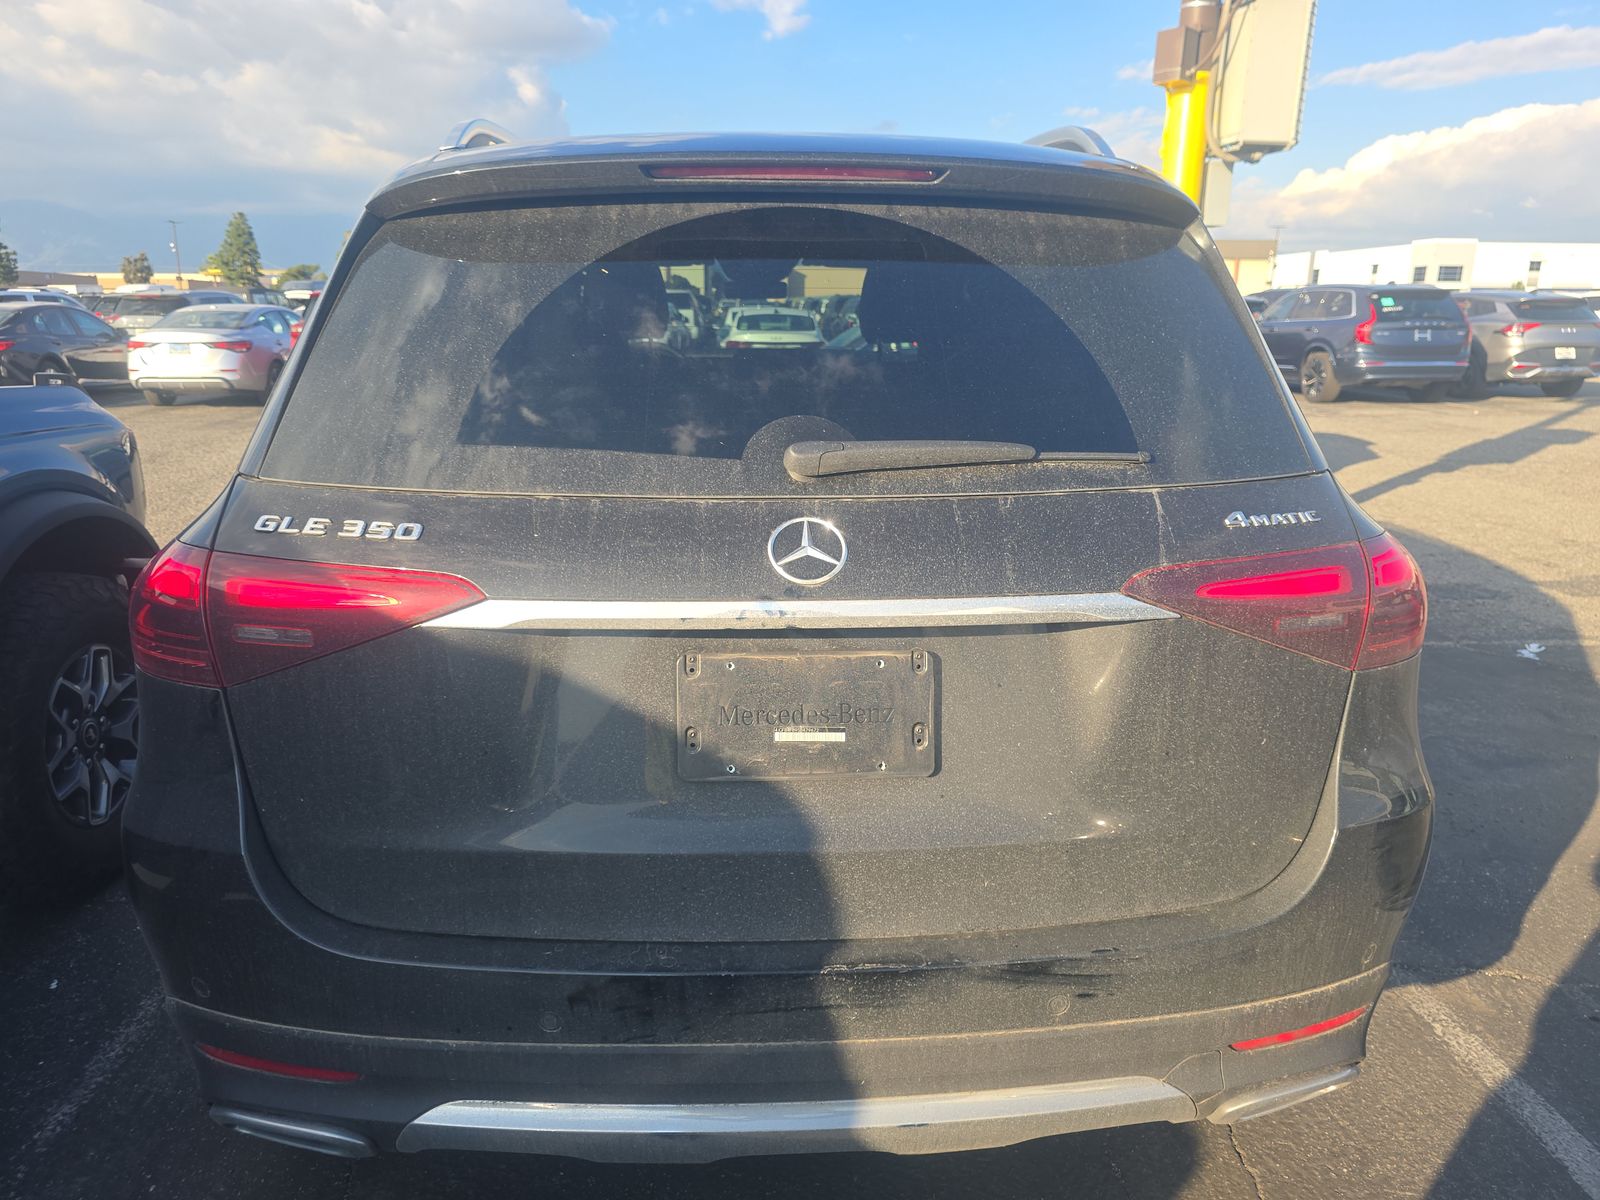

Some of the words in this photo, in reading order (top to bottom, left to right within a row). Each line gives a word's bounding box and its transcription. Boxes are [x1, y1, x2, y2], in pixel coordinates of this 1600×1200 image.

[253, 514, 333, 538] GLE
[337, 519, 424, 542] 350
[1223, 510, 1322, 528] 4MATIC
[719, 703, 895, 726] Mercedes-Benz
